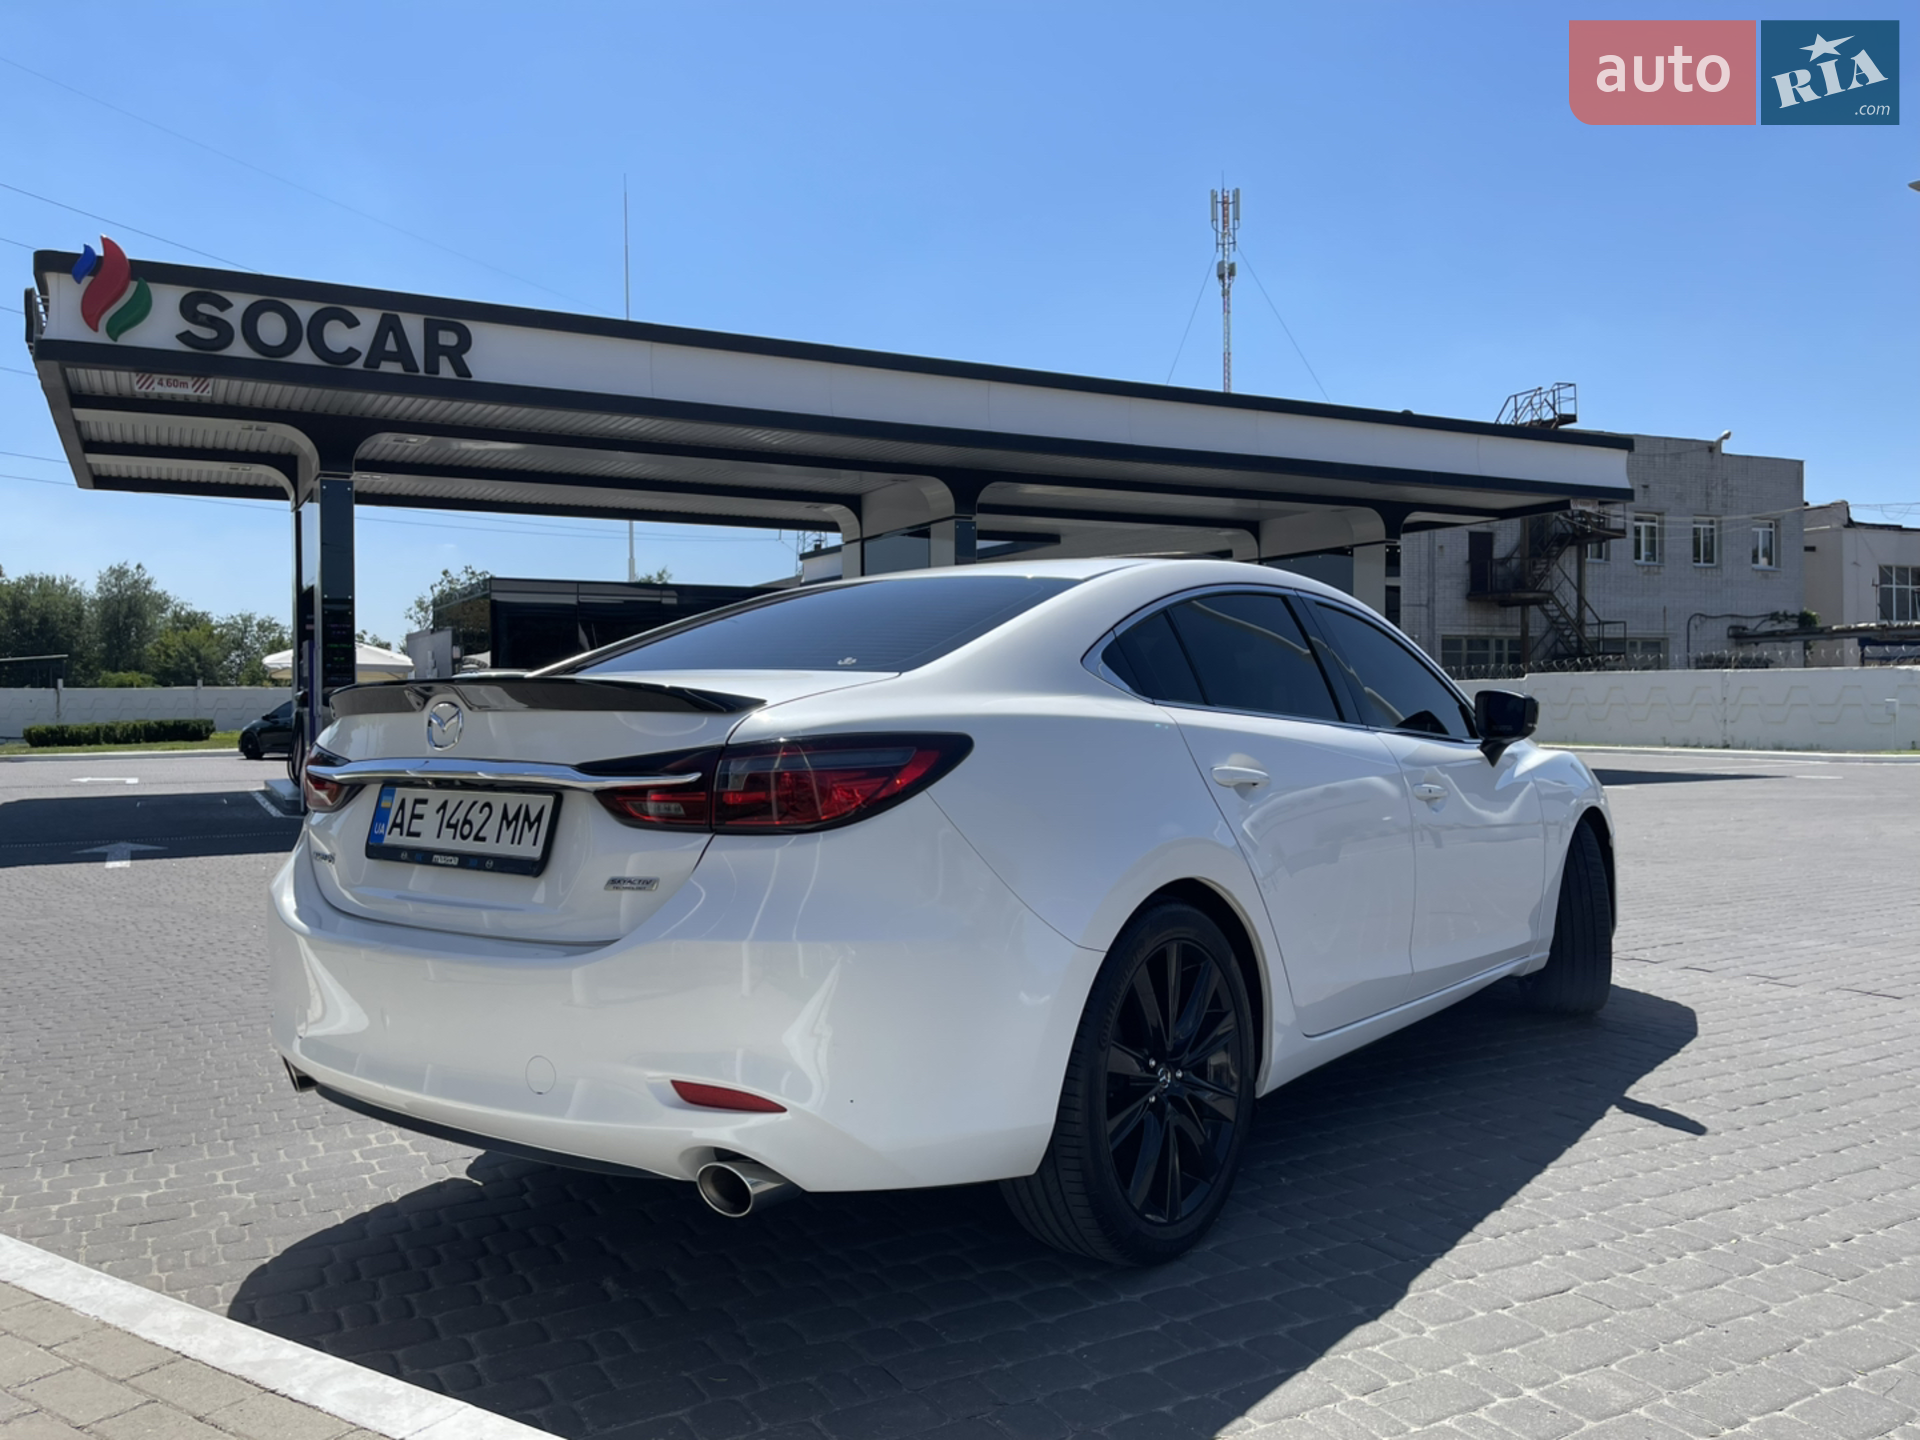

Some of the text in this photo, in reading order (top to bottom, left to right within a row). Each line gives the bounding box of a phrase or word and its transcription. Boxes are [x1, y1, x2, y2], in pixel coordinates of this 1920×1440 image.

[175, 290, 472, 379] SOCAR
[157, 378, 189, 390] 4.60m
[374, 822, 385, 835] UA
[387, 797, 546, 847] AE 1462 MM
